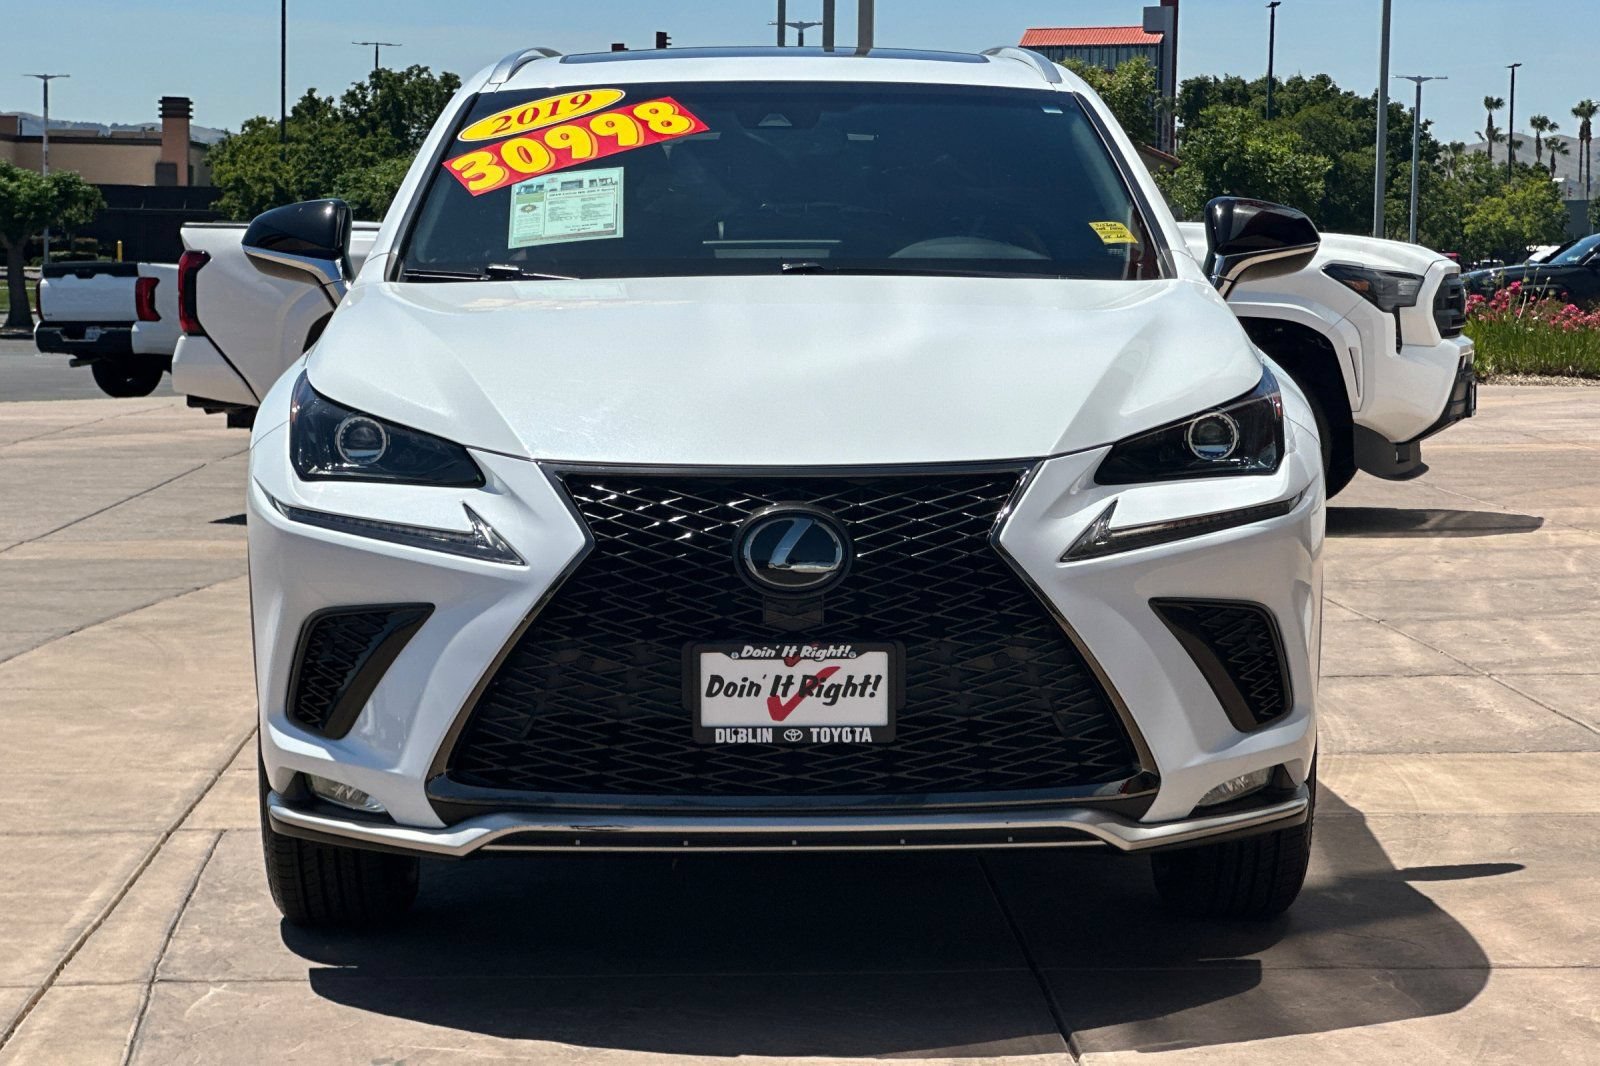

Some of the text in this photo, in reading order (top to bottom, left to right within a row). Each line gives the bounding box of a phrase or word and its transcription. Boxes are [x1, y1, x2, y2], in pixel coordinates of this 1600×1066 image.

[491, 93, 592, 135] 2019
[451, 101, 696, 192] 30998
[741, 645, 851, 662] Doin' It Right!
[705, 674, 883, 707] Doin' It Right!
[715, 728, 873, 744] DUBLIN TOYOTA
